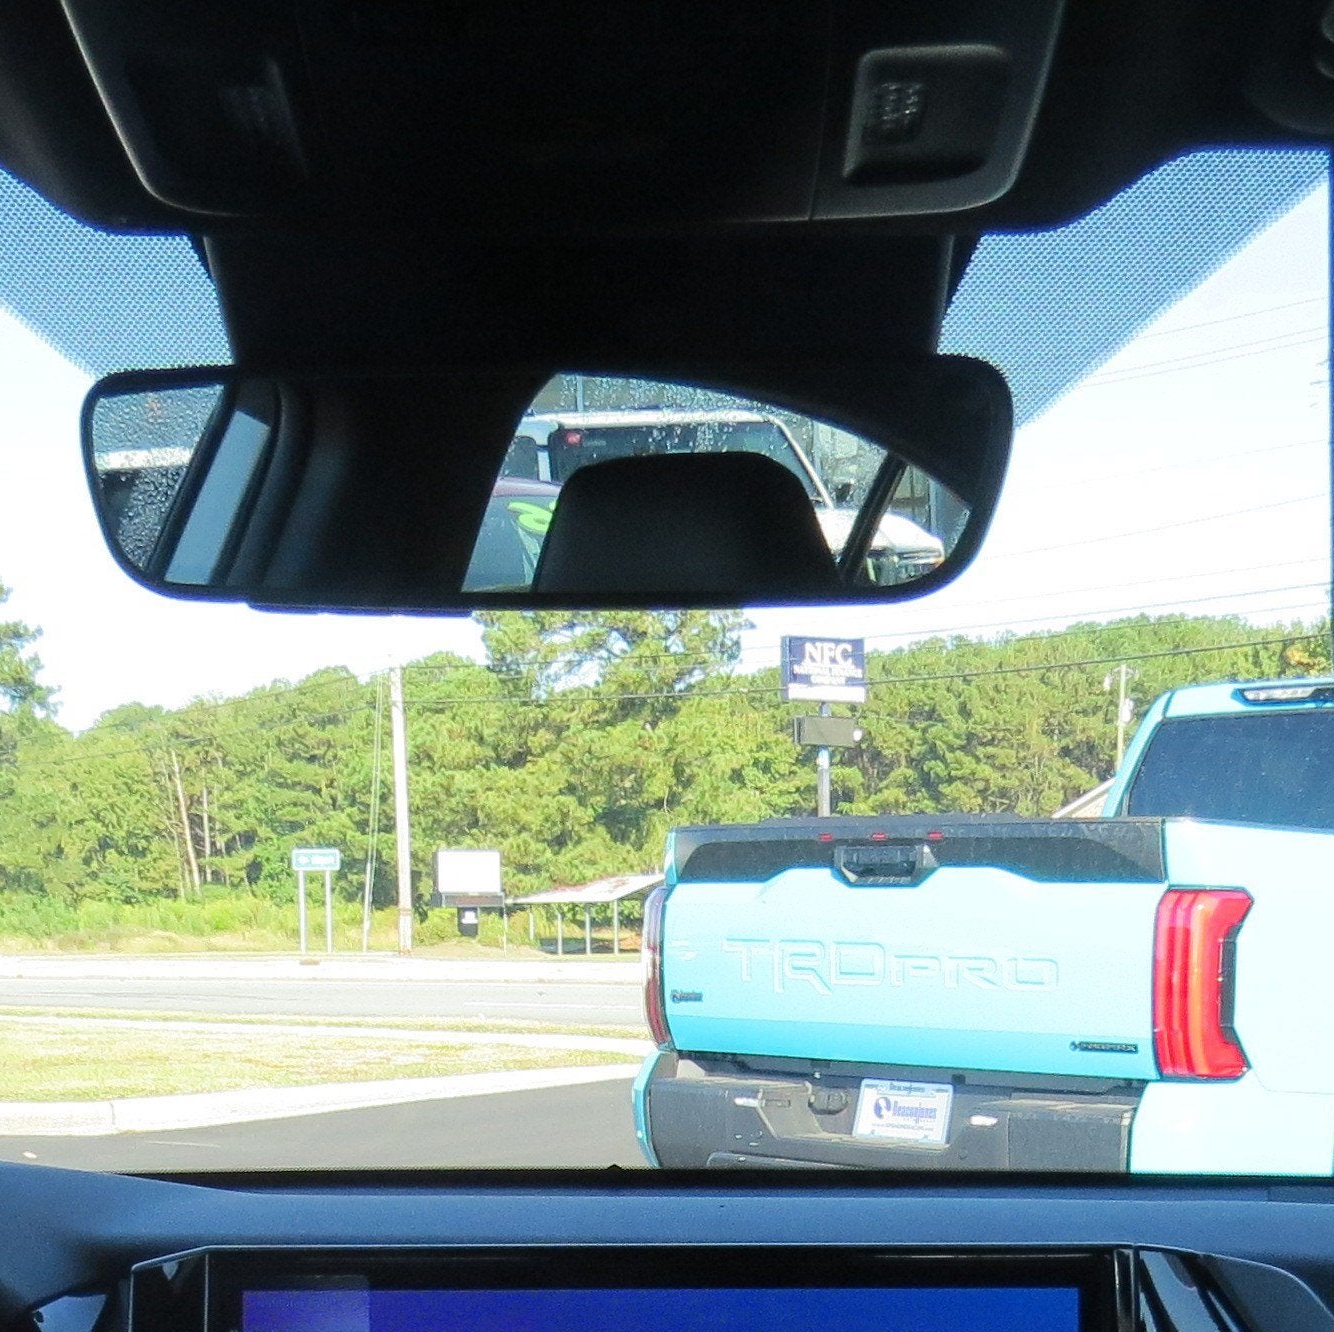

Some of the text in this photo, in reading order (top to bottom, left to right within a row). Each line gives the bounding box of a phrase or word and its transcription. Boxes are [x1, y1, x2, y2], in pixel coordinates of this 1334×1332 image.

[804, 642, 852, 666] NFC
[722, 938, 1060, 995] TRD PRO
